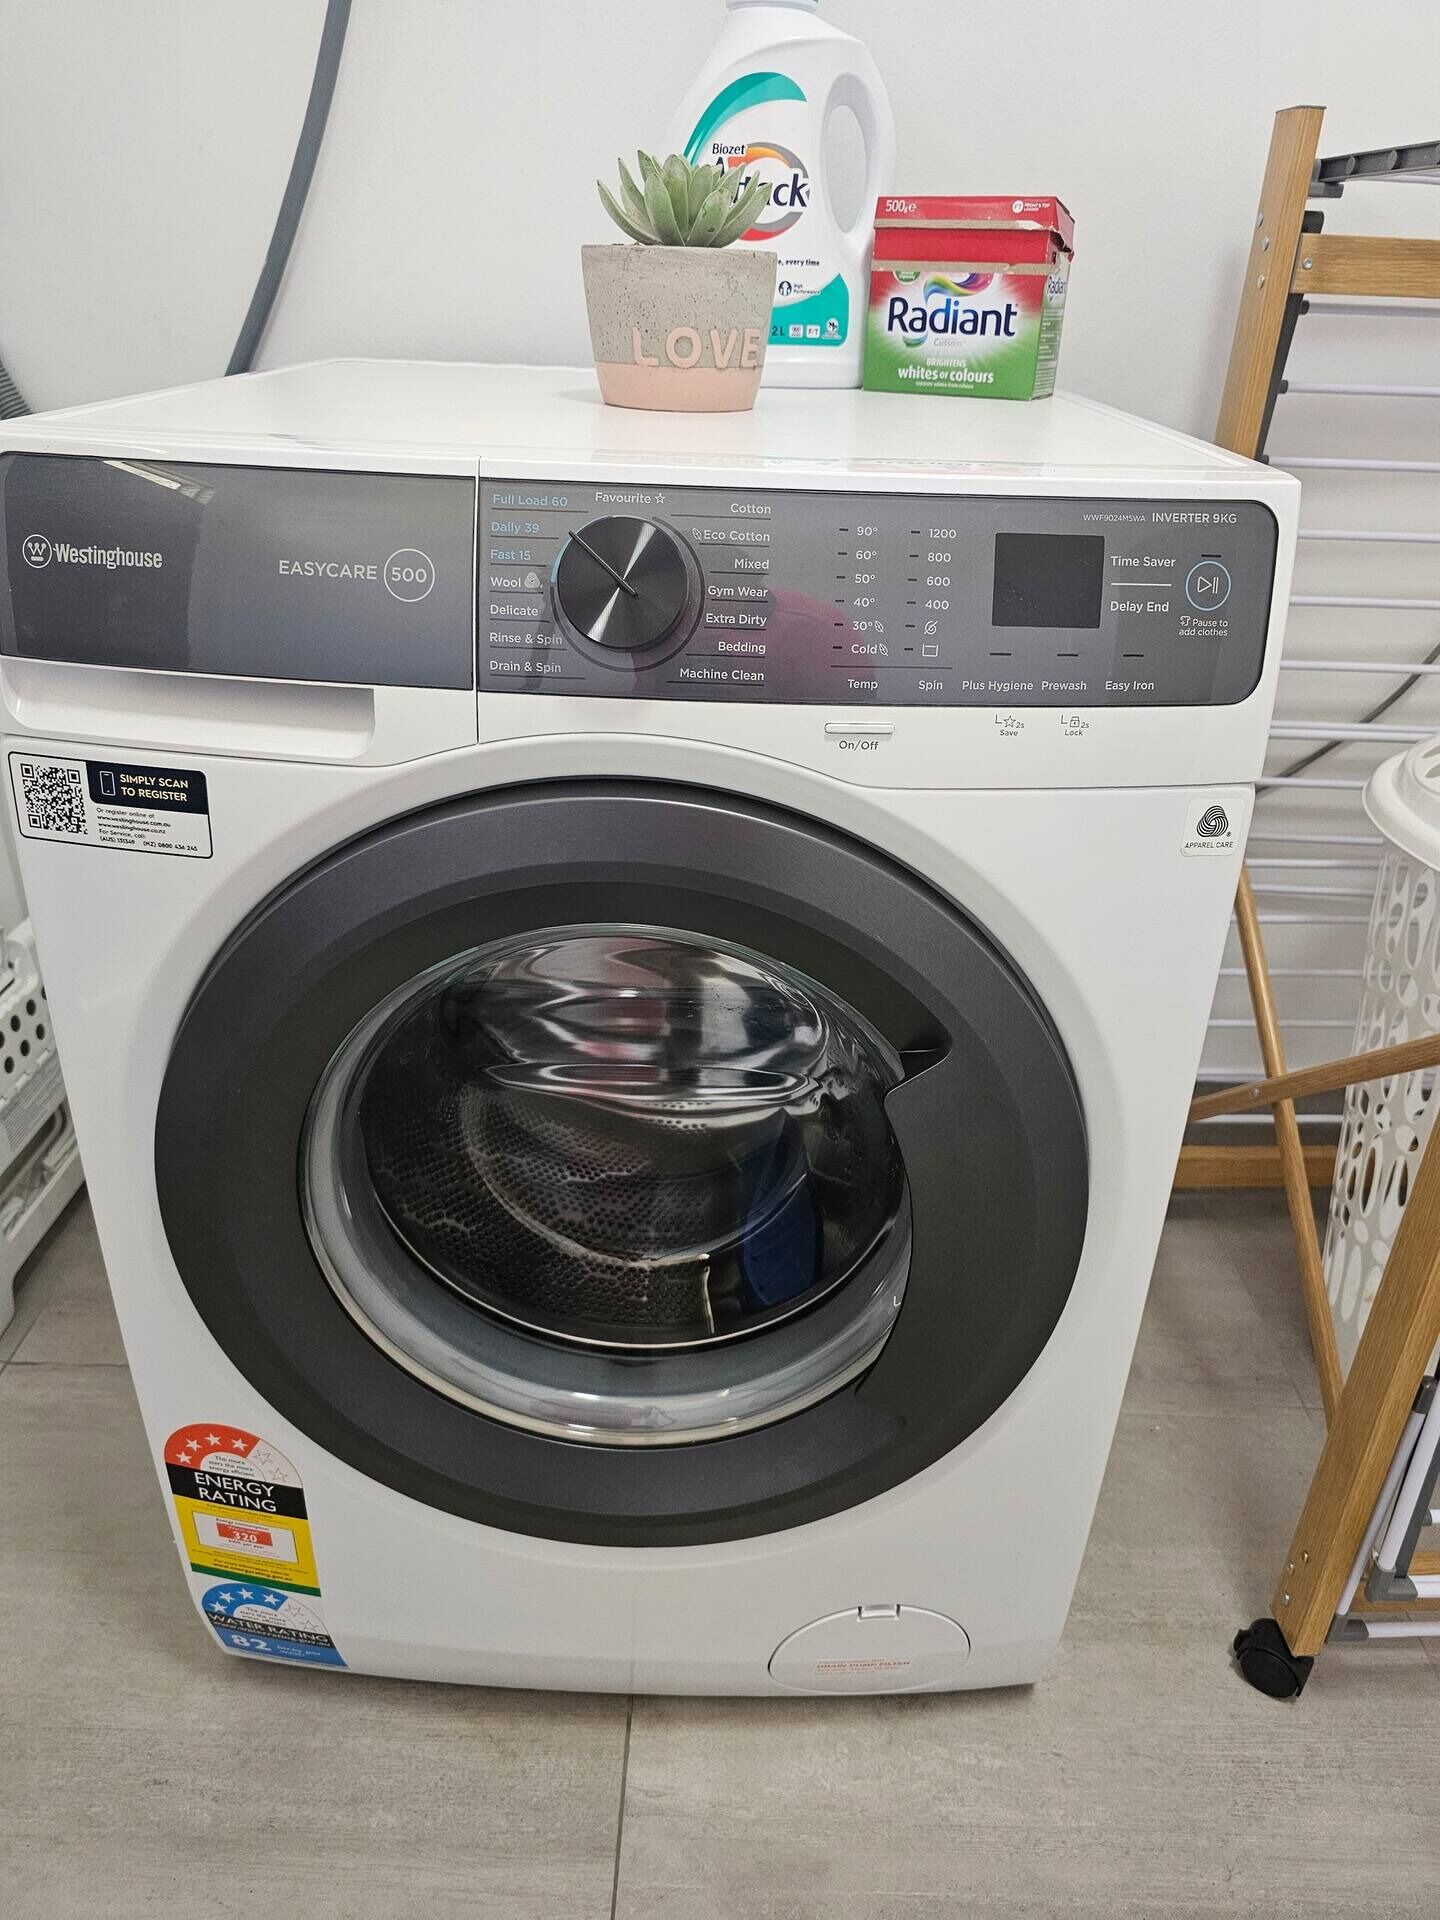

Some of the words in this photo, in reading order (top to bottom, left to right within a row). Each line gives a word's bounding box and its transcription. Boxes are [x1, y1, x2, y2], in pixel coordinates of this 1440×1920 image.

[712, 143, 745, 154] Biozet
[888, 297, 1017, 337] Radiant
[630, 326, 762, 369] LOVE
[926, 358, 966, 368] BRIGHTENS
[898, 365, 938, 380] whites
[940, 371, 950, 379] or
[950, 368, 994, 383] colours
[493, 495, 514, 505] Full
[518, 496, 547, 506] Load
[552, 497, 567, 506] 60
[595, 492, 651, 504] Favourite
[730, 503, 771, 514] Cotton
[1152, 513, 1210, 523] INVERTER
[1213, 513, 1237, 524] 9KG
[491, 522, 520, 534] Daily
[525, 523, 539, 533] 39
[857, 526, 878, 536] 90°
[929, 529, 957, 538] 1200
[704, 530, 726, 540] Eco
[730, 531, 770, 542] Cotton
[55, 543, 162, 569] Westinghouse
[490, 550, 515, 560] Fast
[519, 551, 531, 560] 15
[856, 551, 877, 560] 60°
[928, 553, 951, 562] 800
[734, 558, 770, 570] Mixed
[1111, 556, 1139, 566] Time
[1143, 557, 1176, 567] Saver
[279, 560, 377, 580] EASYCARE
[391, 568, 427, 584] 500
[490, 577, 521, 588] Wool
[855, 574, 875, 583] 50°
[926, 577, 950, 586] 600
[708, 586, 734, 597] Gym
[737, 586, 768, 597] Wear
[854, 598, 875, 607] 40°
[925, 600, 949, 610] 400
[1111, 601, 1143, 613] Delay
[1147, 602, 1169, 612] End
[490, 605, 538, 616] Delicate
[706, 613, 735, 624] Extra
[739, 614, 767, 626] Dirty
[1192, 619, 1217, 627] Pause
[1219, 619, 1228, 627] to
[853, 621, 873, 630] 30°
[1179, 628, 1196, 636] add
[1198, 628, 1228, 636] clothes
[490, 633, 521, 643] Rinse
[525, 634, 534, 643] &
[536, 635, 562, 646] Spin
[718, 642, 766, 654] Bedding
[851, 644, 877, 654] Cold
[490, 661, 520, 671] Drain
[524, 662, 533, 672] &
[536, 662, 561, 674] Spin
[680, 668, 728, 679] Machine
[732, 670, 764, 681] Clean
[848, 680, 878, 690] Temp
[918, 680, 943, 691] Spin
[962, 680, 985, 690] Plus
[988, 680, 1033, 694] Hygiene
[1041, 680, 1087, 691] Prewash
[1105, 680, 1129, 693] Easy
[1132, 680, 1154, 690] Iron
[839, 740, 879, 751] On/Off
[119, 774, 156, 785] SIMPLY
[158, 778, 189, 788] SCAN
[121, 787, 135, 796] TO
[138, 788, 187, 801] REGISTER
[129, 810, 146, 818] online
[97, 815, 171, 827] www.westinghouse.com.au
[98, 822, 166, 834] www.westinghouse.co.nz
[194, 1472, 274, 1497] ENERGY
[198, 1488, 277, 1512] RATING
[233, 1531, 257, 1543] 320
[209, 1614, 266, 1632] WATER
[268, 1625, 328, 1642] RATING
[232, 1634, 272, 1651] 82
